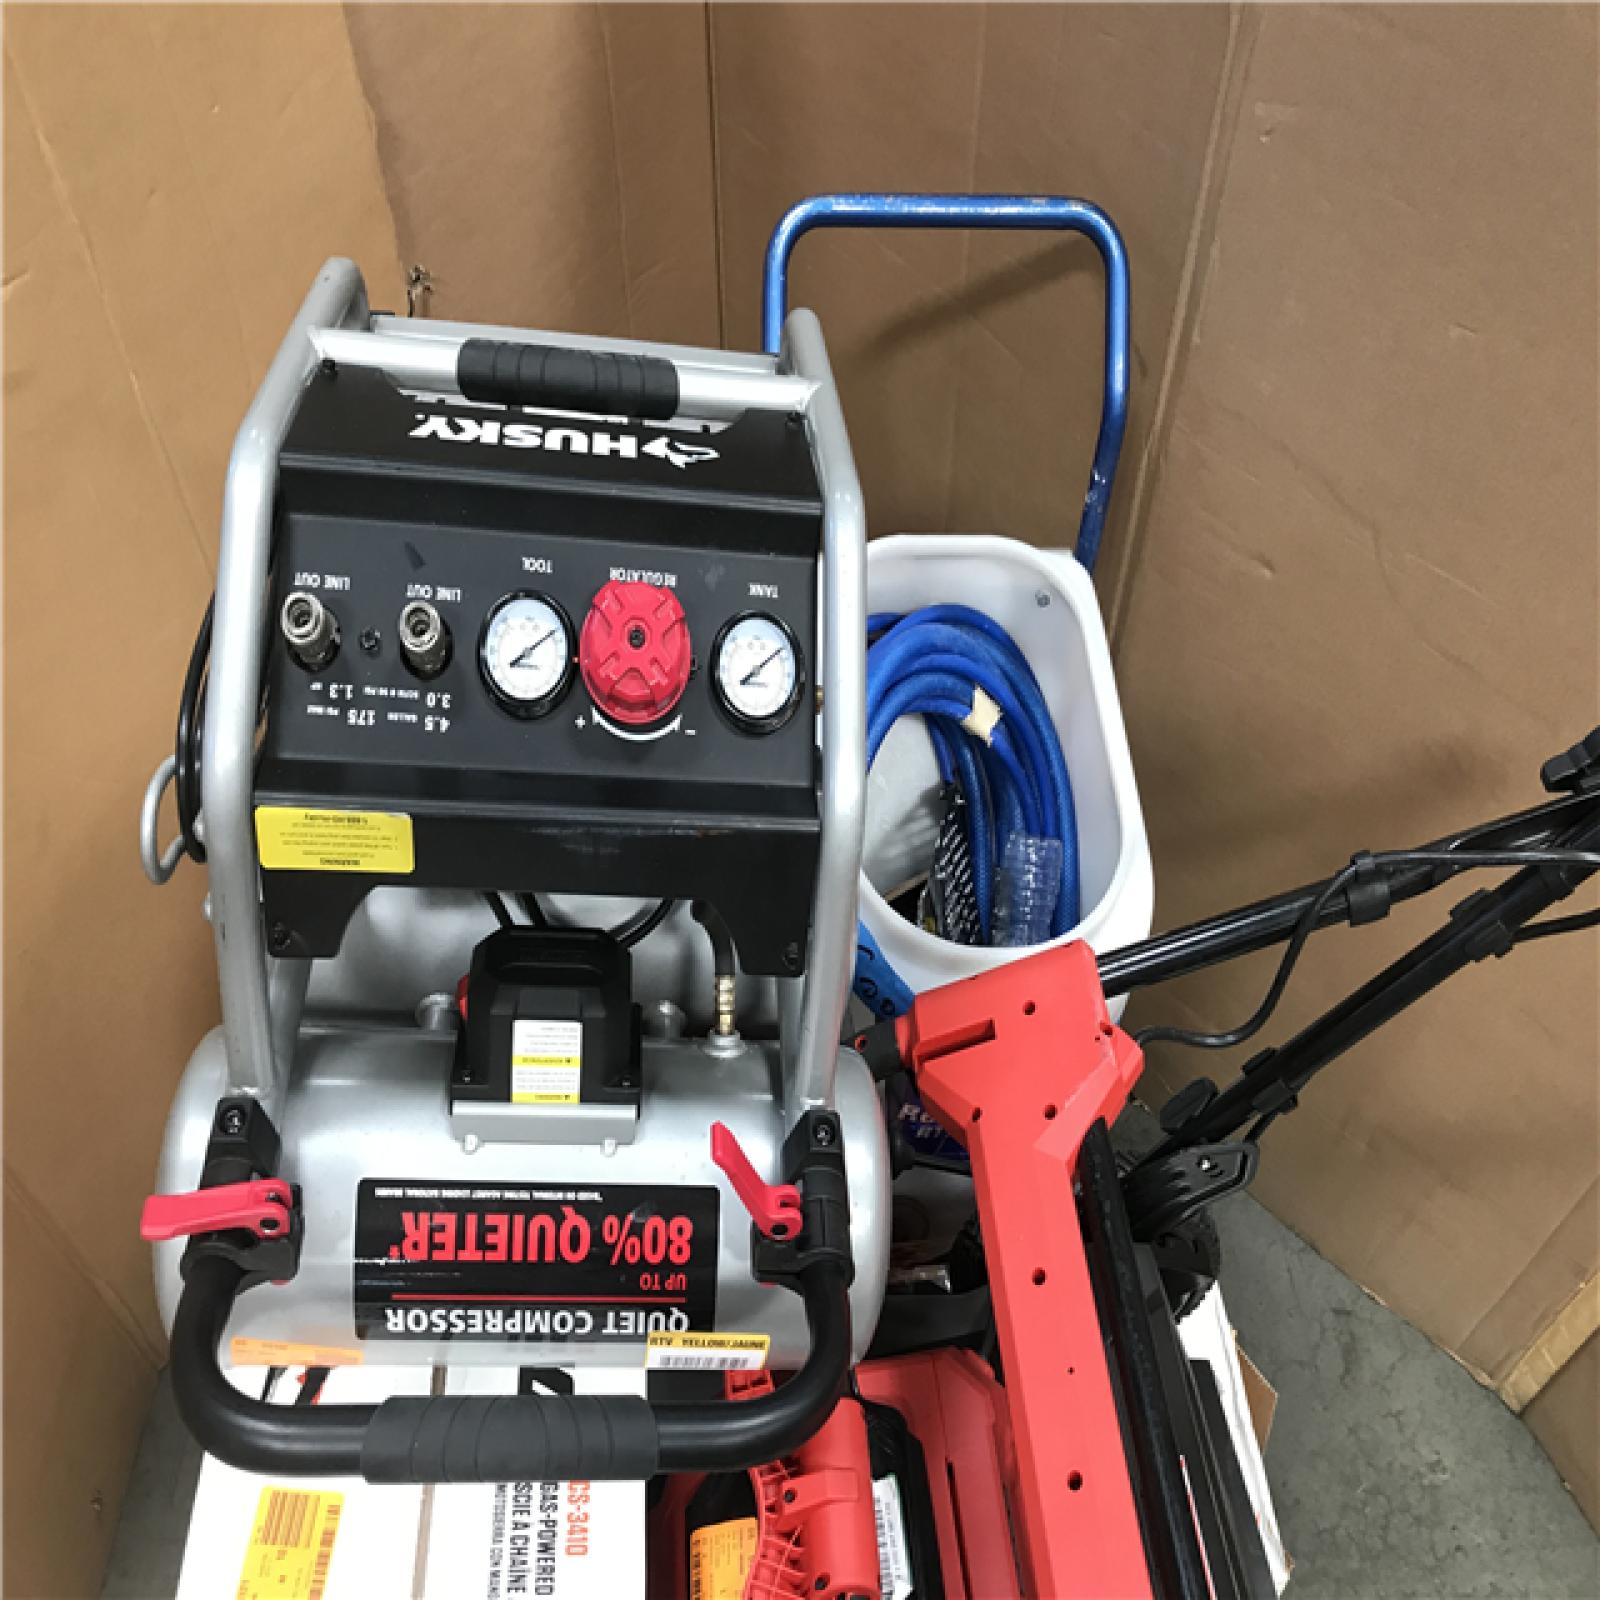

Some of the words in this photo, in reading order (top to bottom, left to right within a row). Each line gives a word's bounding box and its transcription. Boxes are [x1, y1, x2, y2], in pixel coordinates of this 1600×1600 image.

[408, 414, 638, 459] HUSKY
[522, 557, 554, 574] TOOL
[294, 572, 321, 589] OUT
[324, 575, 351, 591] LINE
[609, 567, 678, 586] REGULATOR
[406, 583, 433, 600] OUT
[436, 586, 462, 603] LINE
[748, 582, 780, 599] TANK
[329, 683, 354, 701] 1.3
[425, 692, 451, 708] 3.0
[346, 709, 376, 726] 175
[424, 714, 451, 734] 4.5
[602, 1212, 693, 1267] 80%
[639, 1272, 661, 1290] TO
[664, 1274, 687, 1291] UP
[384, 1307, 594, 1334] COMPRESSOR
[602, 1306, 690, 1334] QUIET
[512, 1482, 532, 1517] SCIE
[565, 1480, 591, 1557] CS-3410
[535, 1482, 558, 1596] GAS-POWERED
